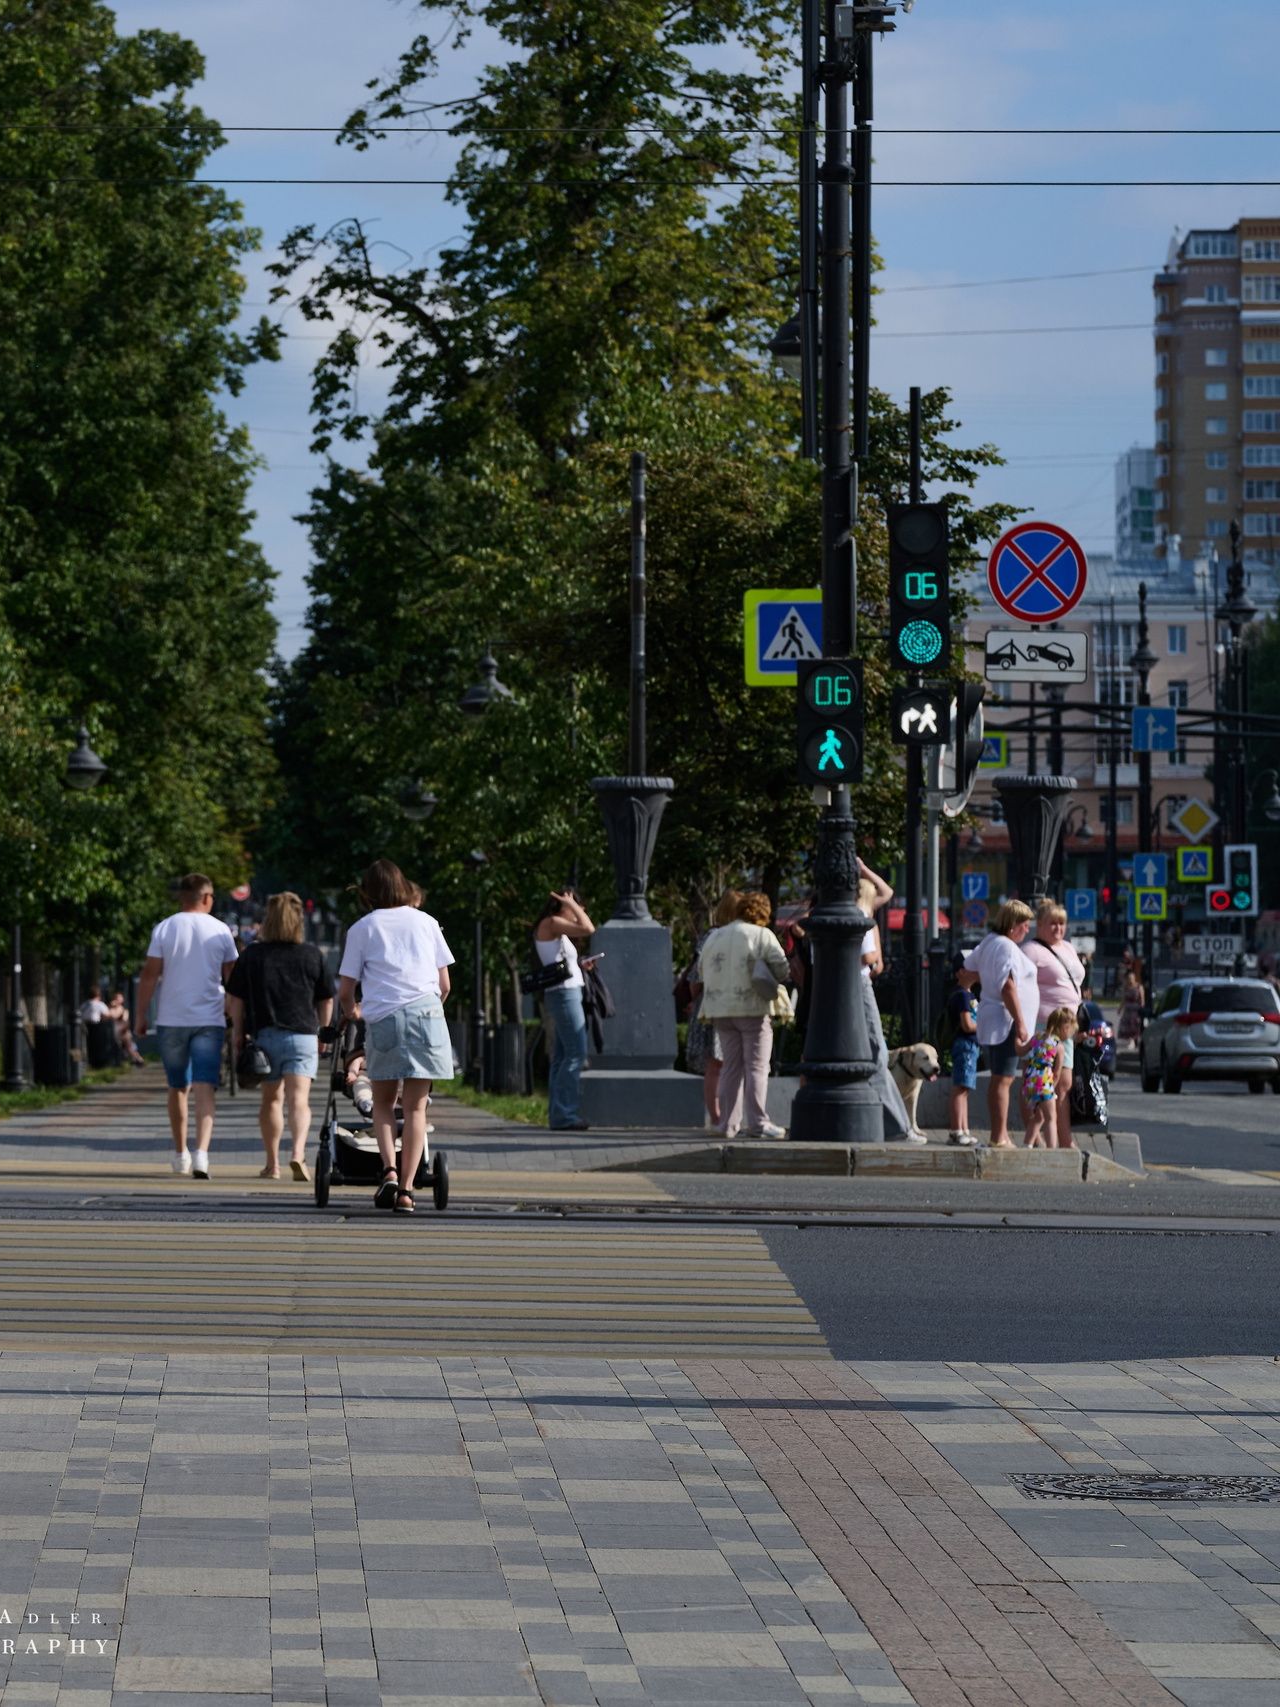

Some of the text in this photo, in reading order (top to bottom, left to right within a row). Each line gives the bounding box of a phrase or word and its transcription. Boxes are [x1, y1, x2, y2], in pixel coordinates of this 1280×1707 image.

[905, 572, 938, 600] 06
[815, 676, 852, 706] 06
[1191, 938, 1234, 952] СТОП
